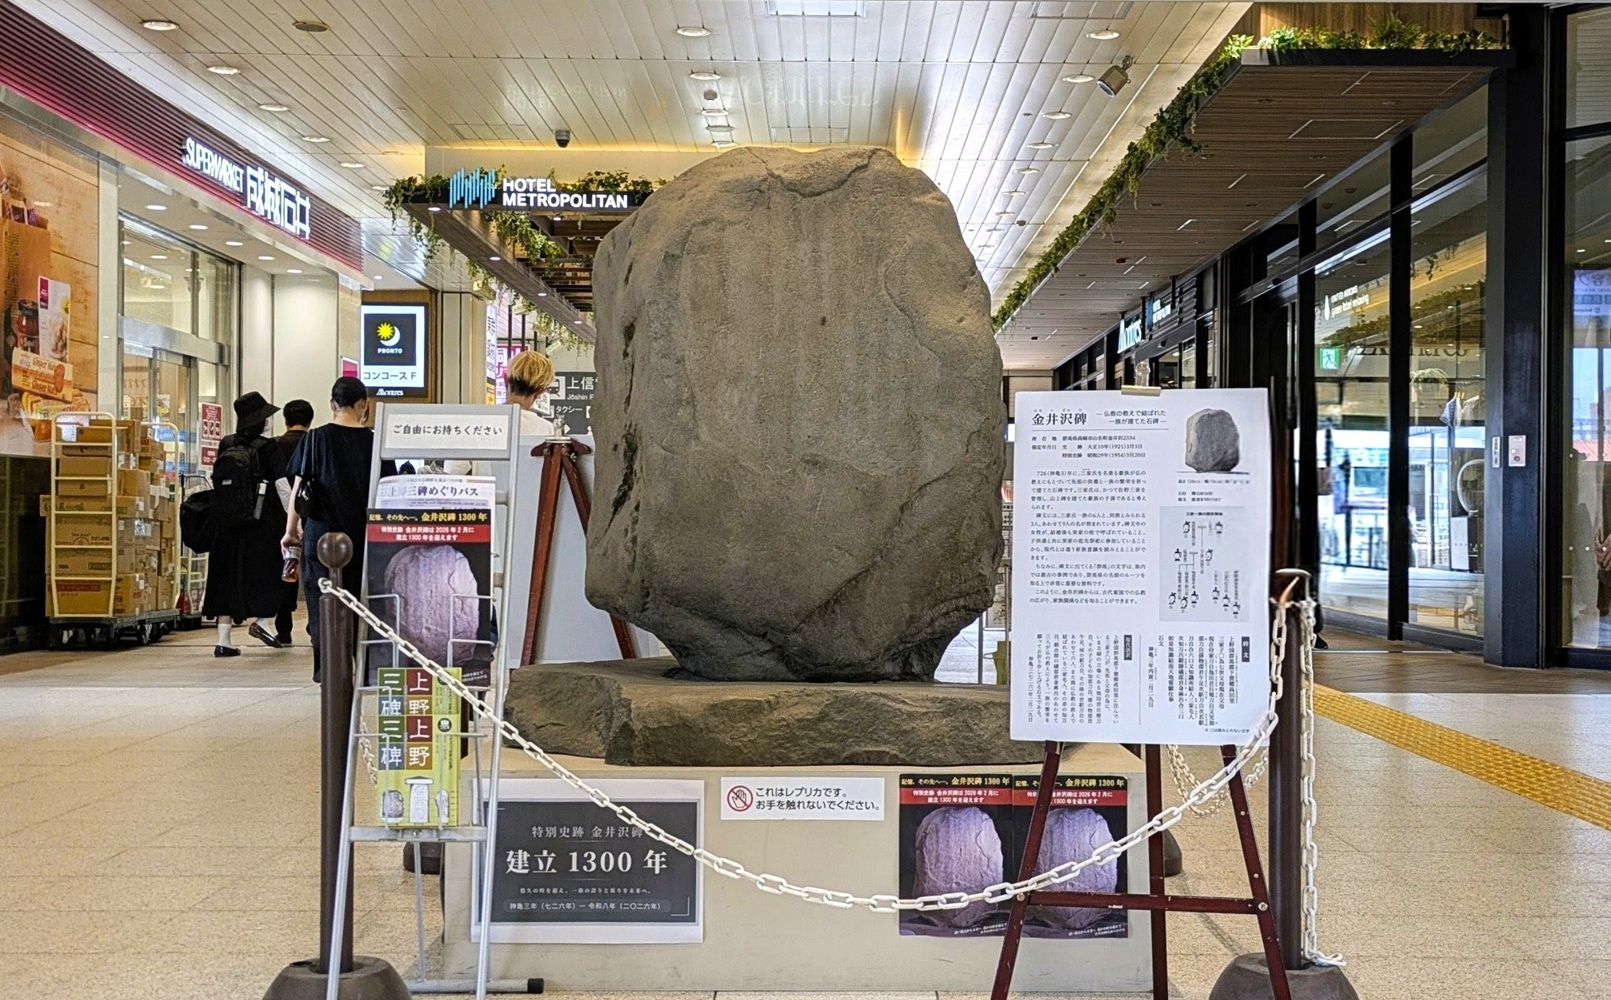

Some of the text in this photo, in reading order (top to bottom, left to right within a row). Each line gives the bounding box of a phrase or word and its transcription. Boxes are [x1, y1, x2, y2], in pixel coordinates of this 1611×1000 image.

[187, 137, 245, 194] SUPERMARKET
[503, 178, 557, 192] HOTEL
[246, 165, 311, 240] 成城石井
[503, 192, 628, 209] METROPOLITAN
[363, 371, 418, 380] コンコース F
[567, 376, 599, 391] 上信
[556, 406, 583, 414] タクシー
[1032, 412, 1087, 426] 金井沢碑
[393, 424, 502, 436] ご自由にお持ちください
[422, 512, 456, 522] 金井沢碑
[459, 513, 477, 521] 1300
[479, 512, 488, 522] 年
[381, 720, 403, 768] 三碑
[409, 719, 431, 766] 上野
[952, 777, 983, 786] 金井沢碑
[1002, 777, 1010, 786] 年
[1066, 778, 1097, 787] 金井沢碑
[1099, 779, 1115, 787] 1300
[1116, 779, 1125, 787] 年
[756, 786, 847, 798] これはレプリカです。
[756, 800, 880, 811] お手を触れないでください。
[532, 825, 643, 838] 特別史跡 金井沢碑
[506, 849, 668, 875] 建立 1300 年
